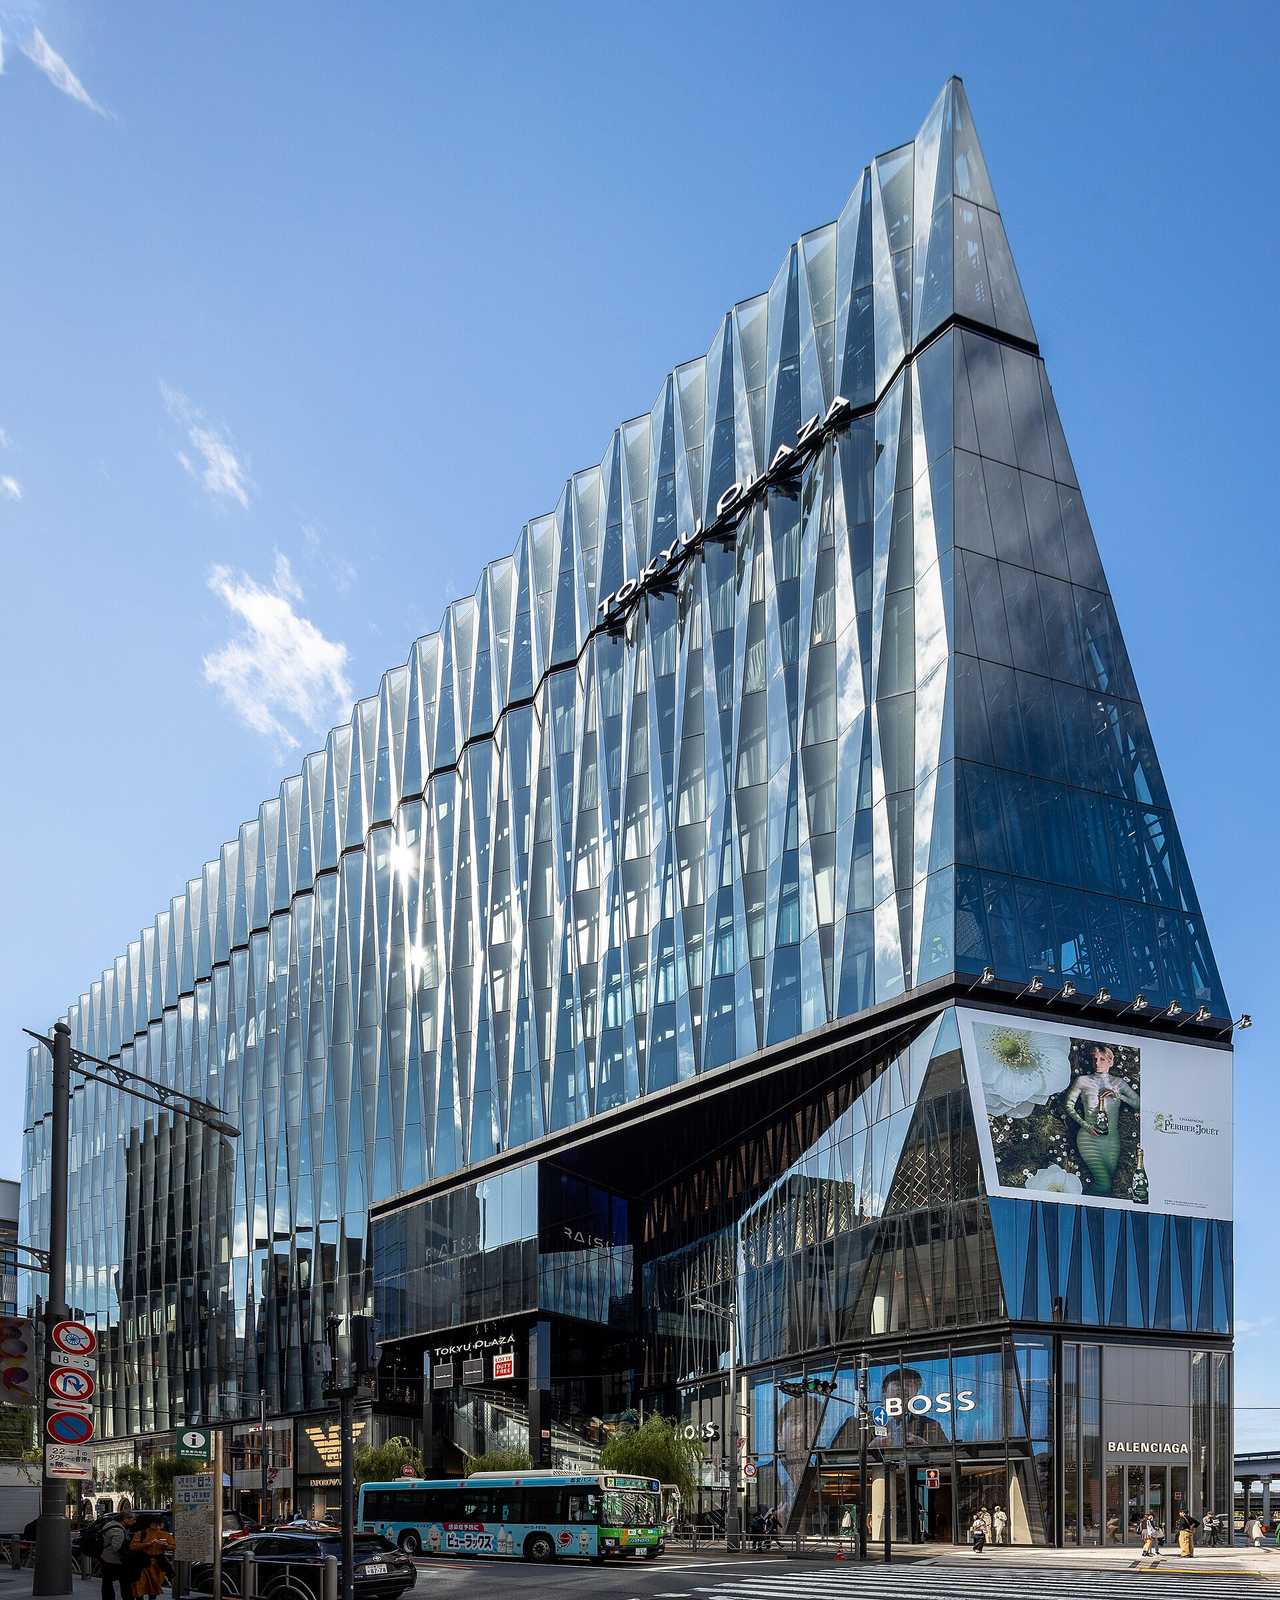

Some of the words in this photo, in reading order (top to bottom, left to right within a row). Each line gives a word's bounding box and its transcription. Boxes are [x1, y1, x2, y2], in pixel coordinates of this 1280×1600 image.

[598, 519, 702, 618] TOKYU
[716, 395, 850, 520] PLAZA
[434, 1343, 471, 1356] TOKYU
[474, 1335, 515, 1349] PLAZA
[496, 1367, 511, 1375] FREE
[885, 1391, 976, 1416] BOSS
[1108, 1441, 1188, 1453] BALENCIAGA
[447, 1533, 493, 1549] ピューラックス
